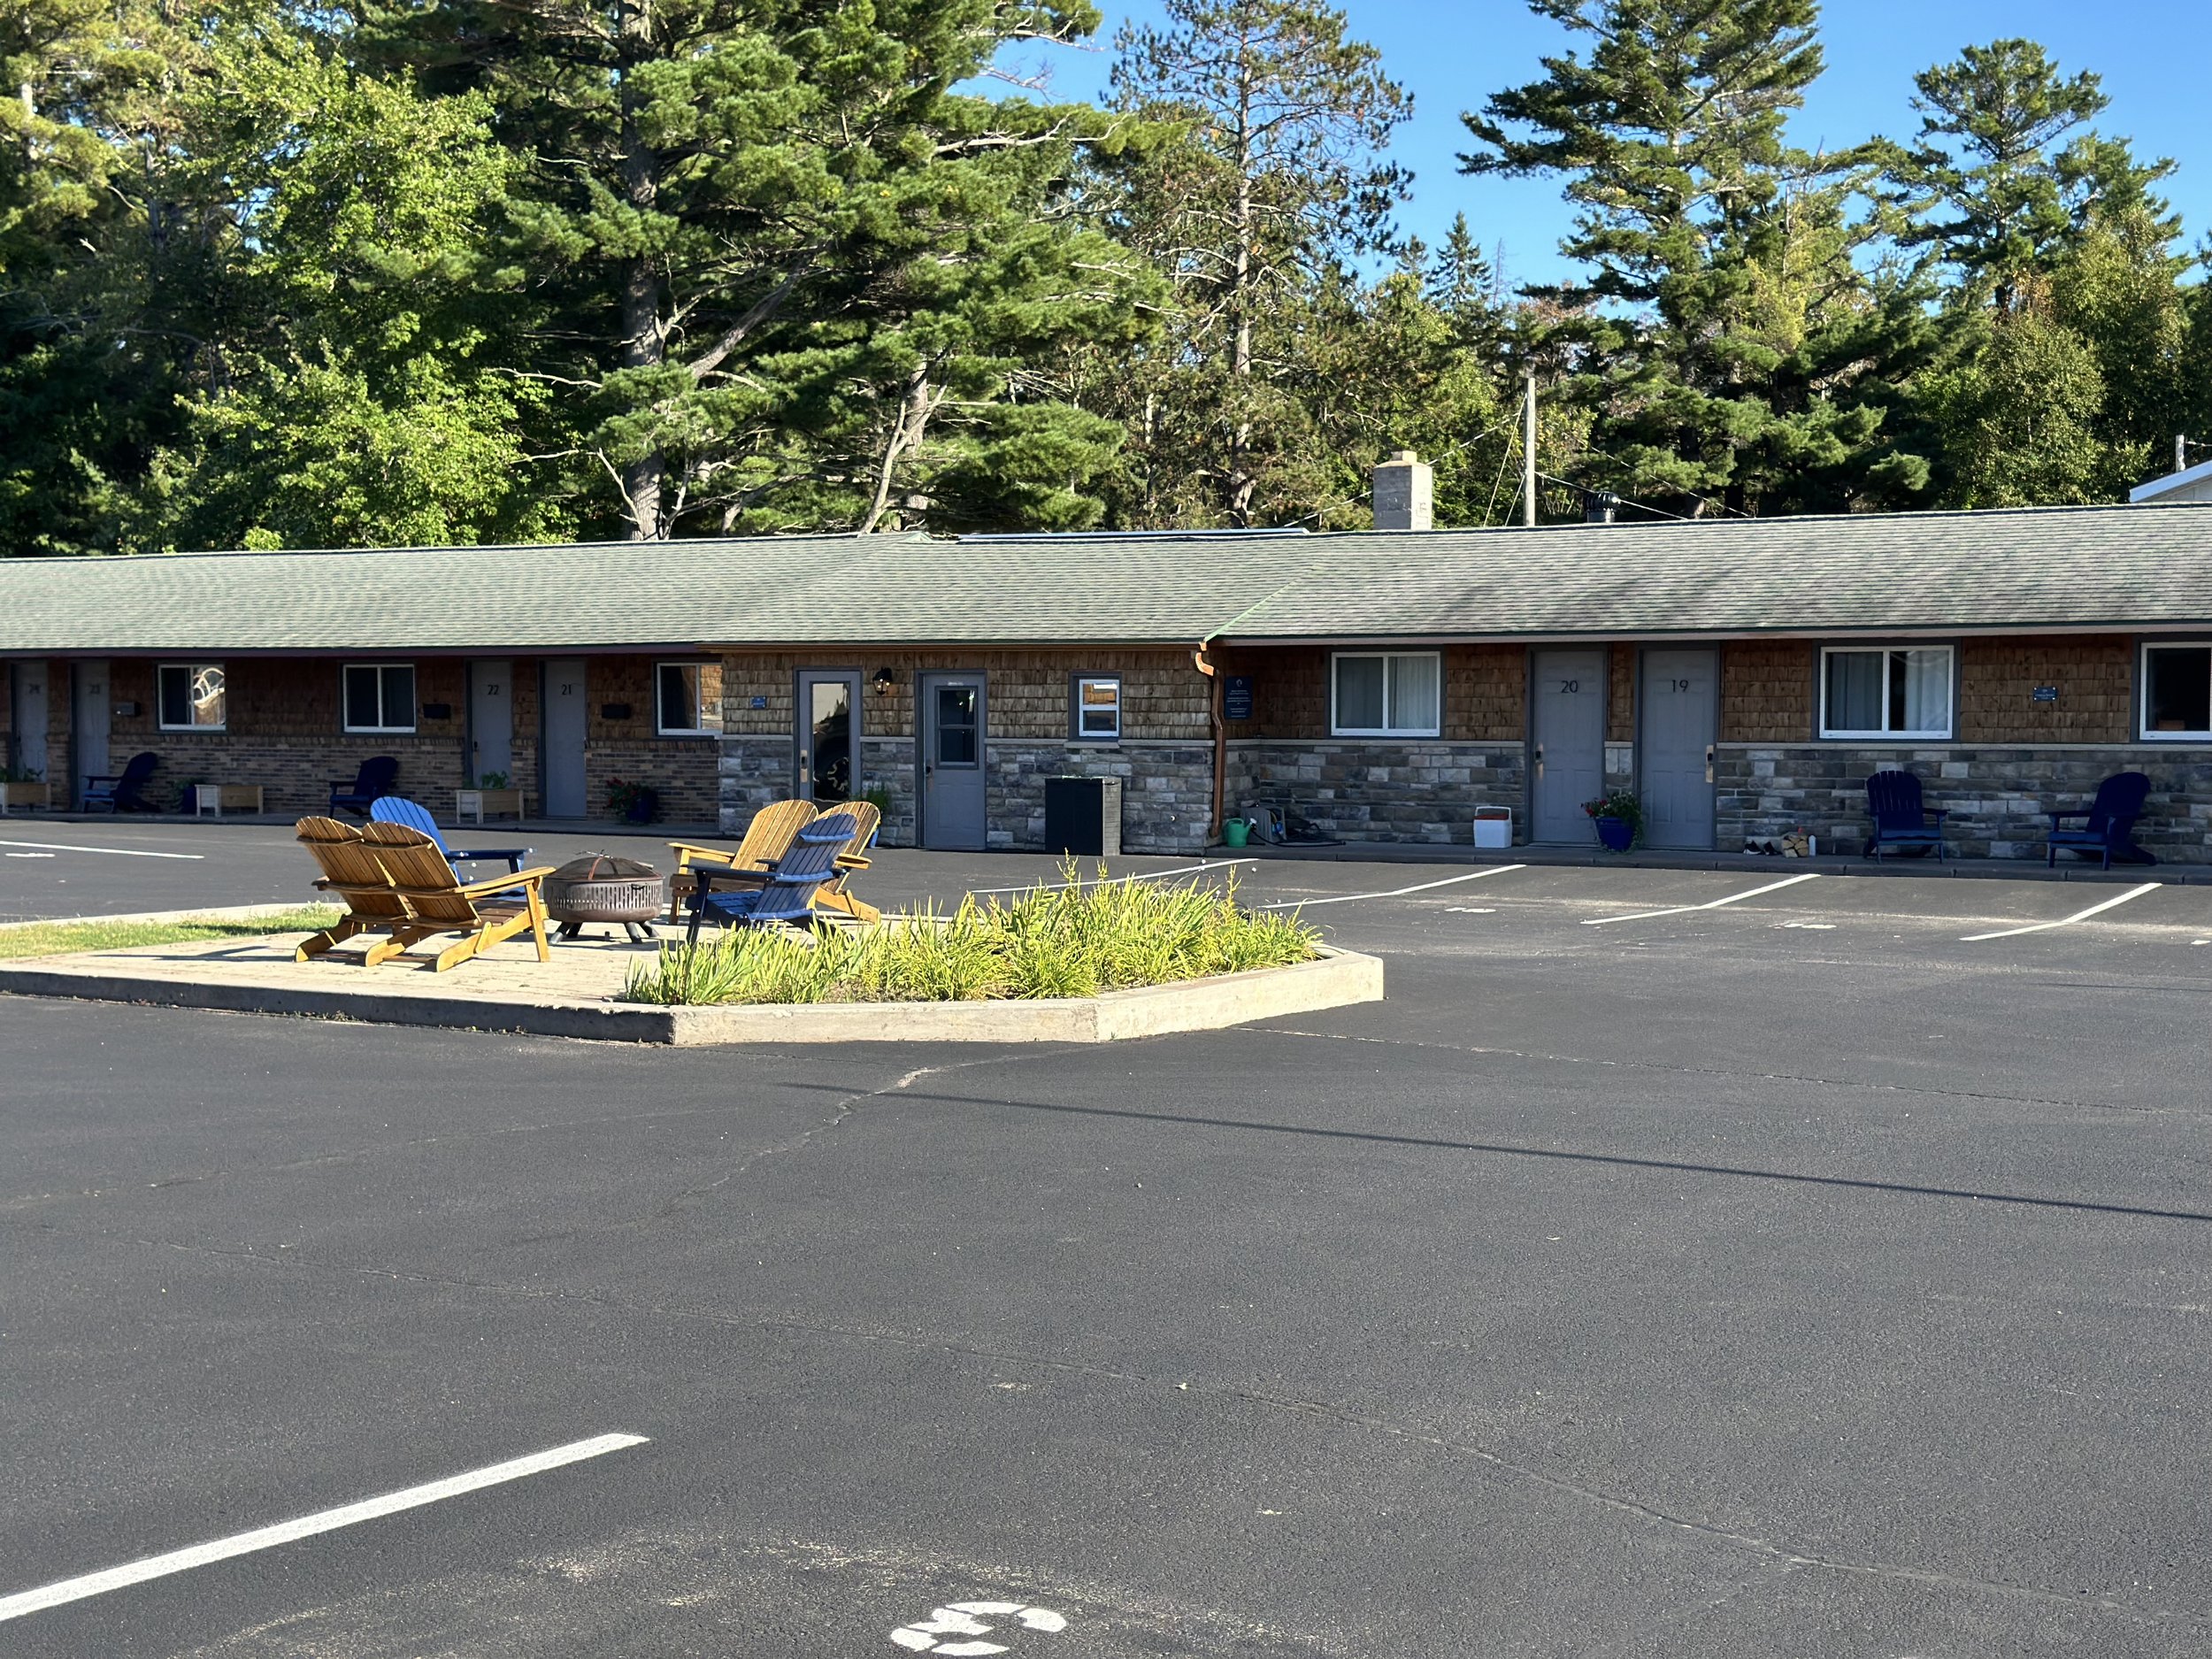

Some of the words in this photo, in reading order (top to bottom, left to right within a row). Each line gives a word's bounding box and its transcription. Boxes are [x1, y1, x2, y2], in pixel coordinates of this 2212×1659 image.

[488, 684, 500, 695] 22
[561, 684, 572, 695] 21
[1560, 680, 1579, 694] 20
[1671, 679, 1690, 693] 19
